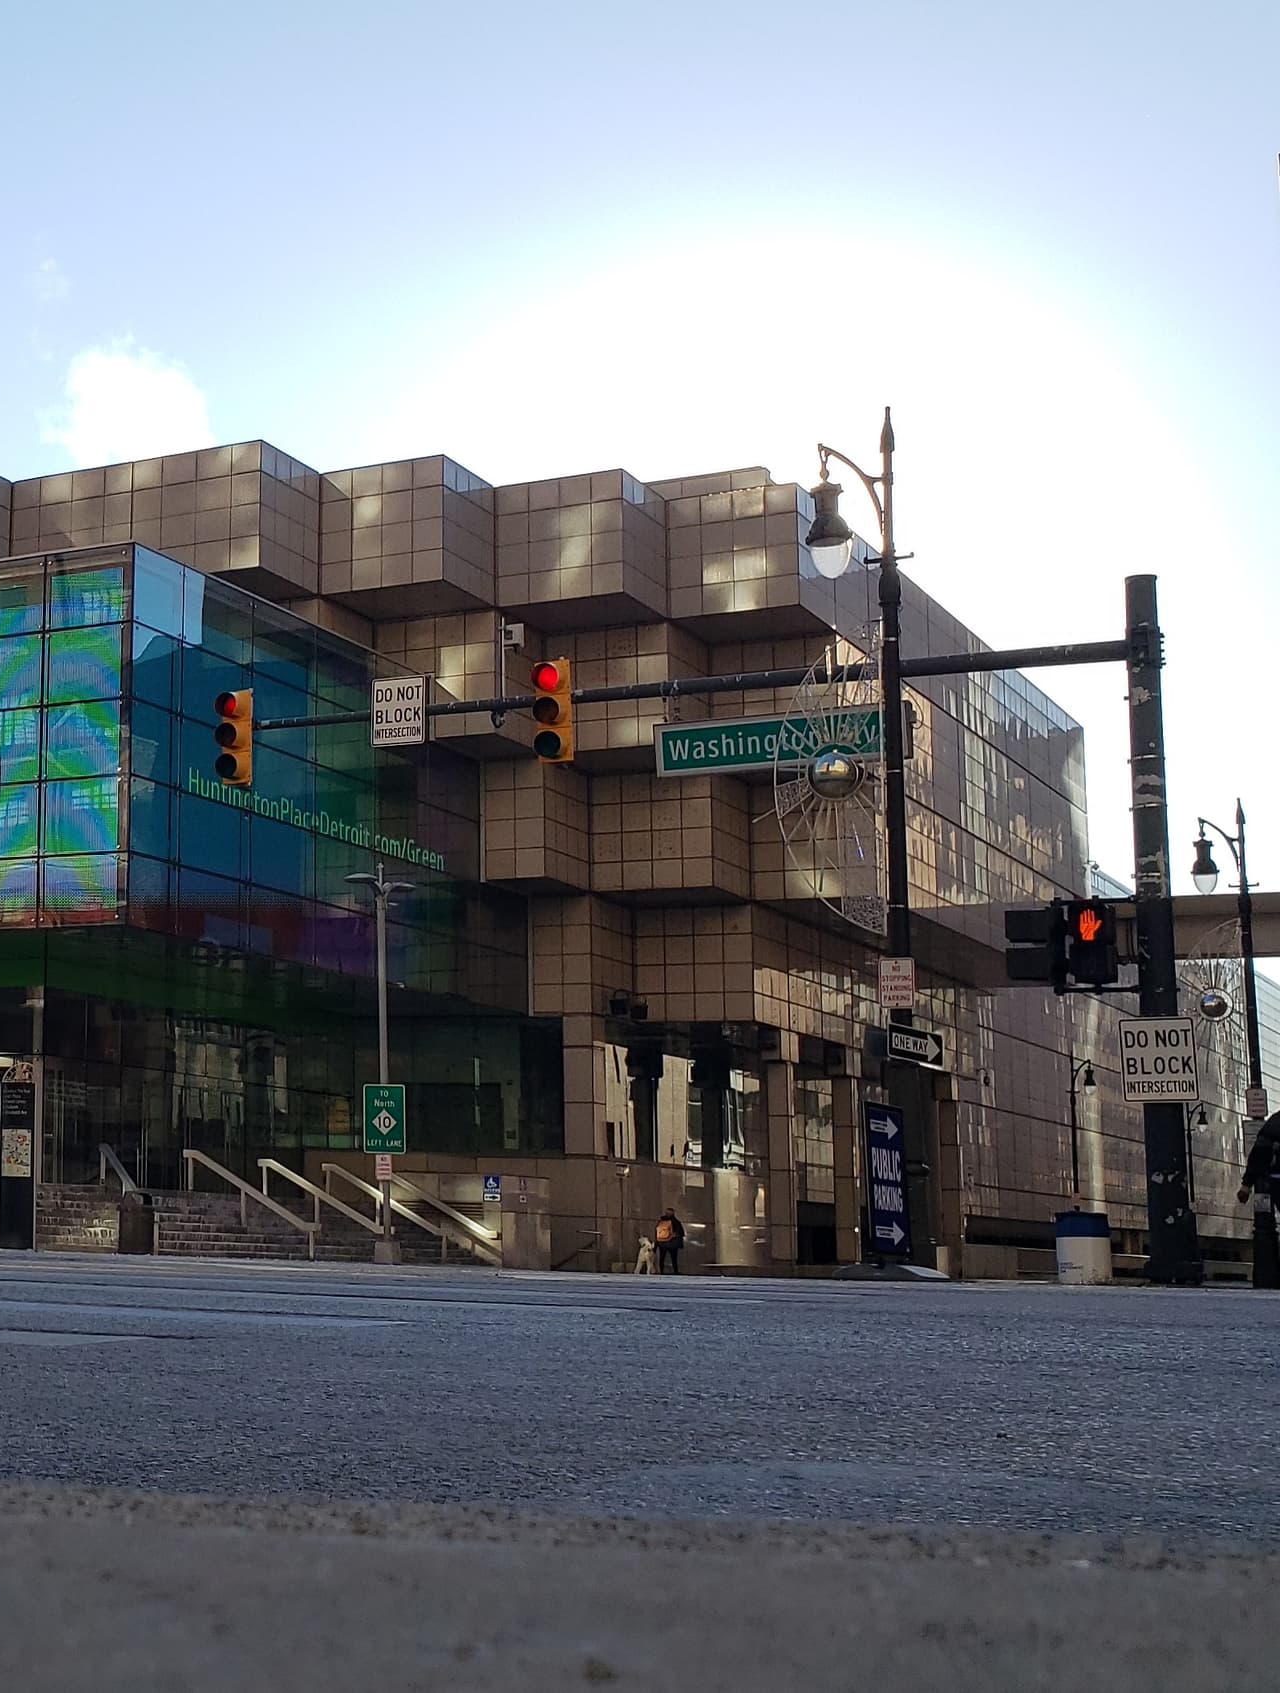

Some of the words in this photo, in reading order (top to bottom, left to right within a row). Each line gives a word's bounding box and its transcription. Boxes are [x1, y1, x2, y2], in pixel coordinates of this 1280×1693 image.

[375, 687, 393, 703] DO
[396, 684, 422, 701] NOT
[375, 706, 421, 724] BLOCK
[374, 725, 421, 740] INTERSECTION
[668, 728, 822, 761] Washington
[893, 1033, 911, 1049] ONE
[911, 1038, 928, 1053] WAY
[1123, 1029, 1149, 1049] DO
[1154, 1028, 1191, 1048] NOT
[1126, 1055, 1194, 1075] BLOCK
[380, 1089, 389, 1097] TO
[1126, 1080, 1195, 1094] INTERSECTION
[373, 1098, 395, 1108] North
[377, 1116, 392, 1129] 10
[871, 1146, 902, 1183] PUBLIC
[873, 1184, 903, 1213] PARKING
